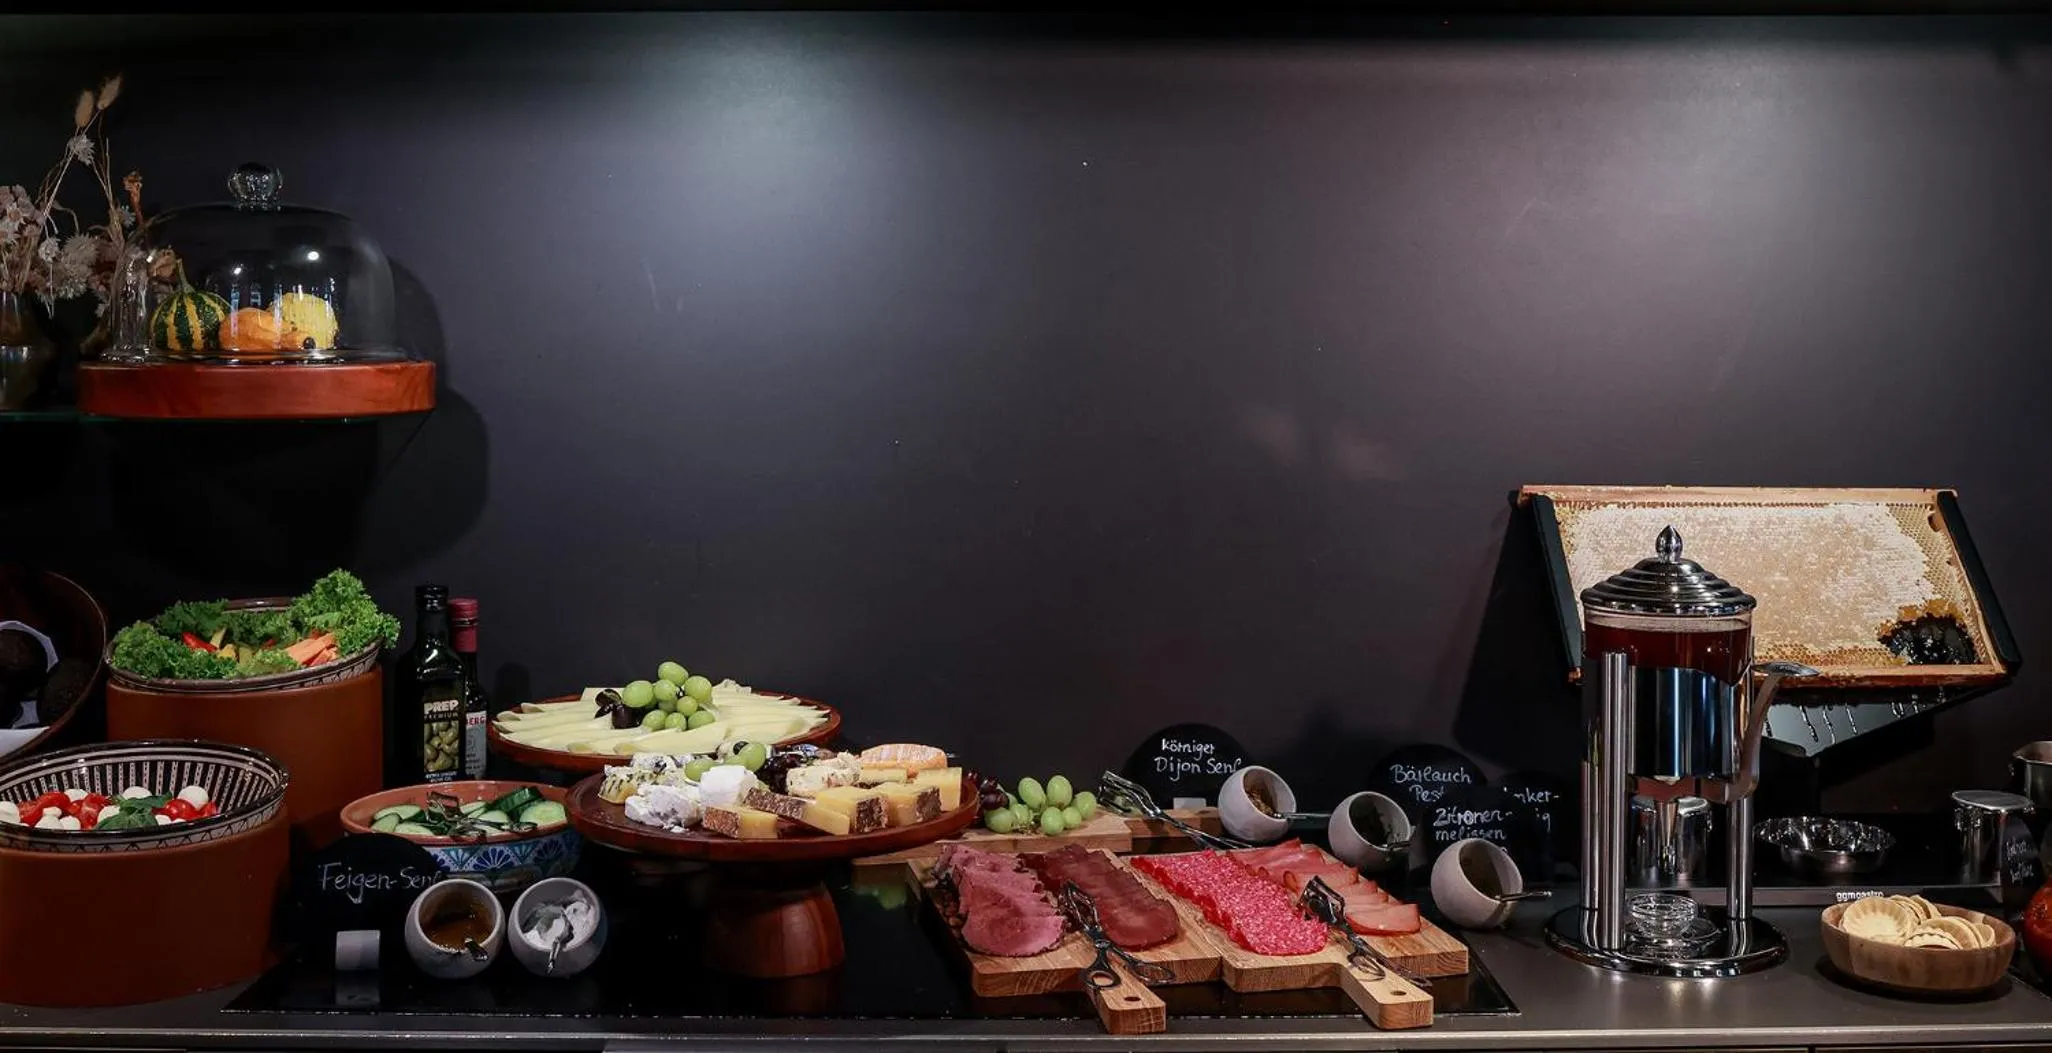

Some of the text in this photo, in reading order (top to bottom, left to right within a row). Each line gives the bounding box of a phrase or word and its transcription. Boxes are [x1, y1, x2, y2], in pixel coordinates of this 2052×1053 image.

[423, 699, 459, 715] PREP
[1161, 738, 1215, 760] körniger
[1154, 756, 1201, 781] Dijon
[1390, 764, 1472, 784] Bärlauch
[1409, 784, 1446, 802] Pest
[1433, 806, 1513, 827] Zitronen-
